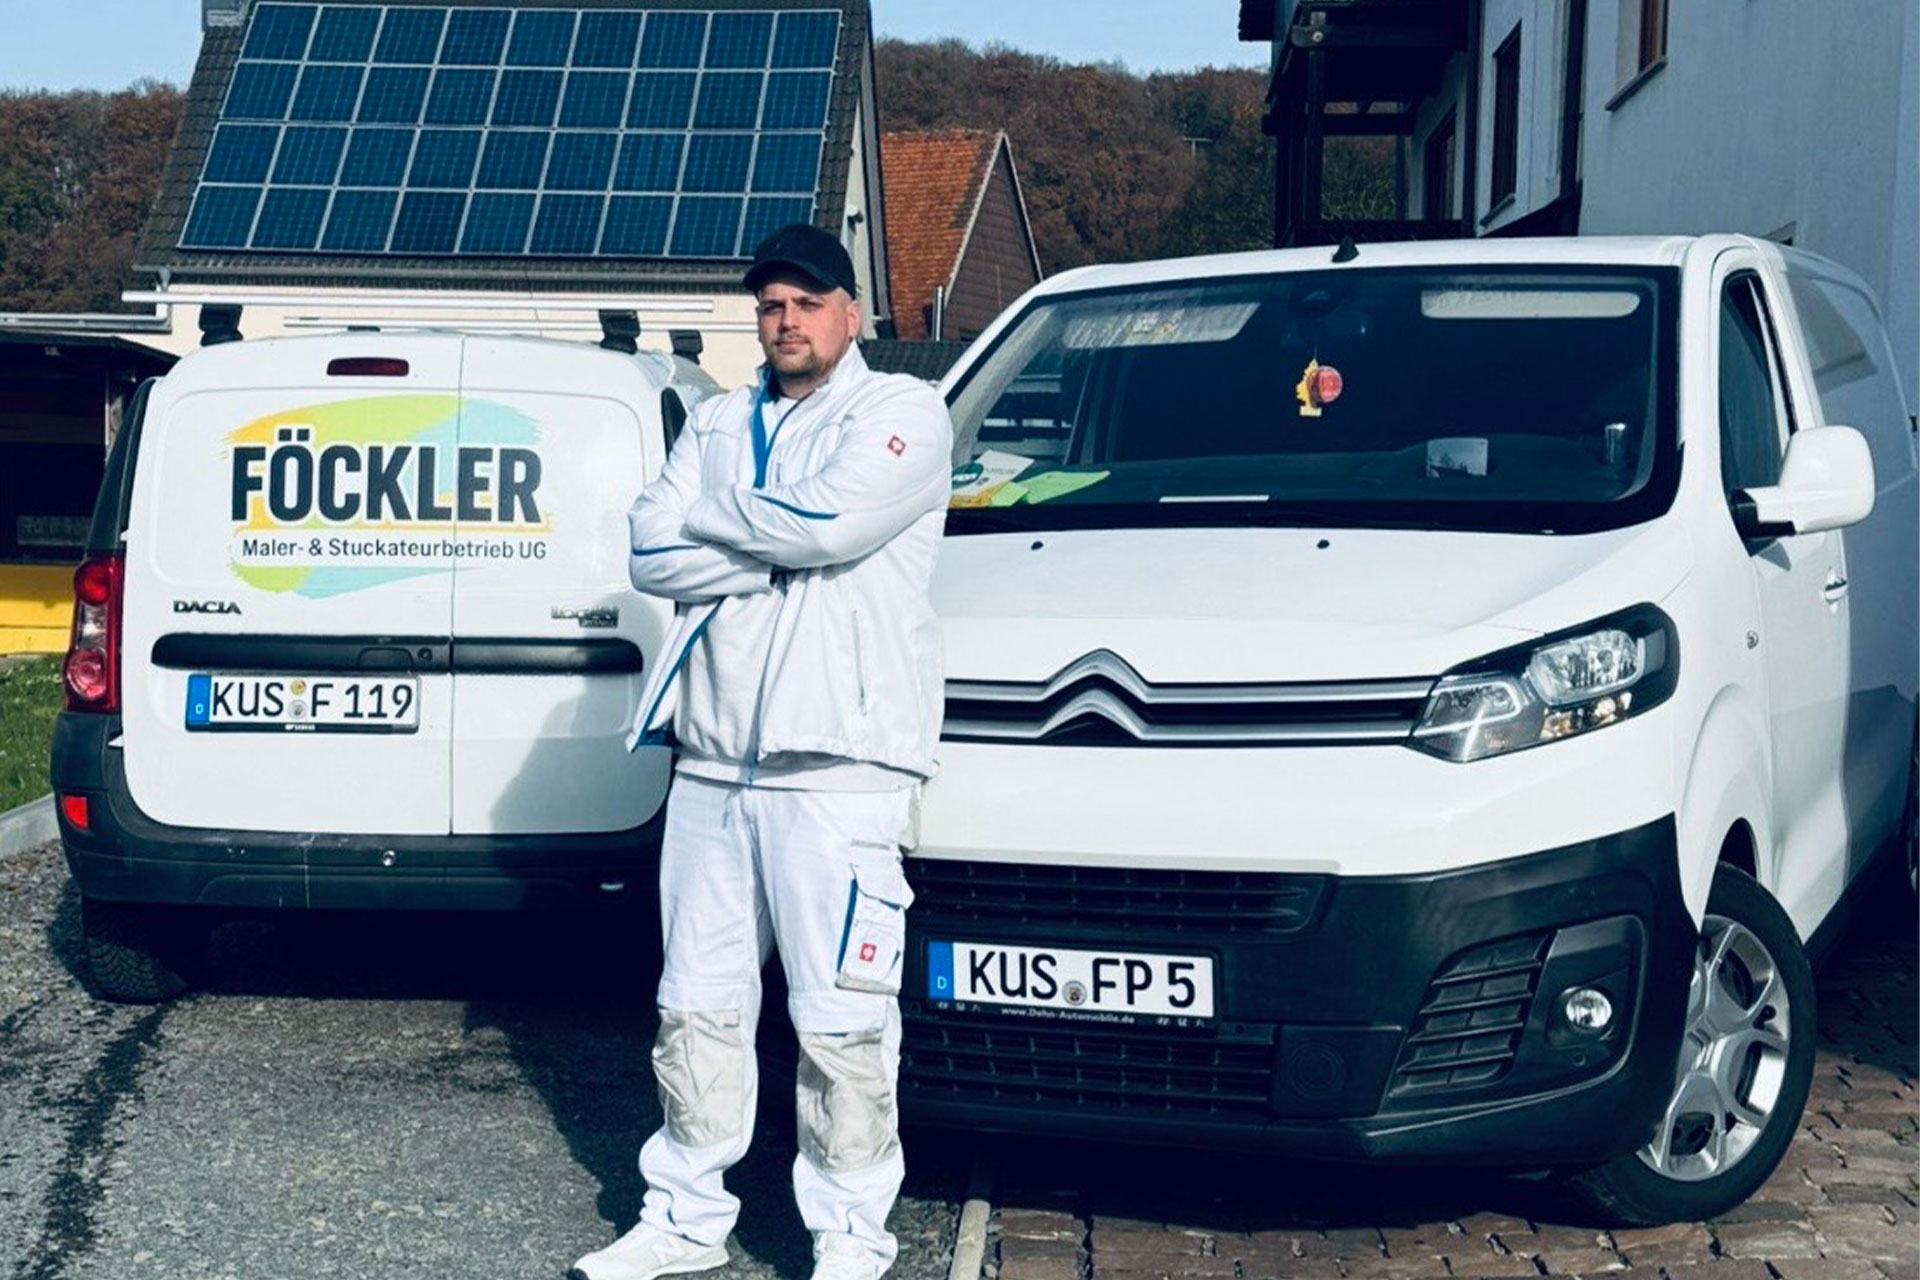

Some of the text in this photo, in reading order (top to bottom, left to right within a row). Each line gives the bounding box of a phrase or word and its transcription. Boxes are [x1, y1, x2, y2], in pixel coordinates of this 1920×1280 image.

[231, 428, 542, 524] FÖCKLER
[242, 537, 547, 560] Maler- & Stuckateurbetrieb UG
[173, 600, 242, 615] DACIA
[211, 681, 414, 719] KUS F 119
[936, 975, 948, 990] D
[969, 949, 1196, 1009] KUS FP 5
